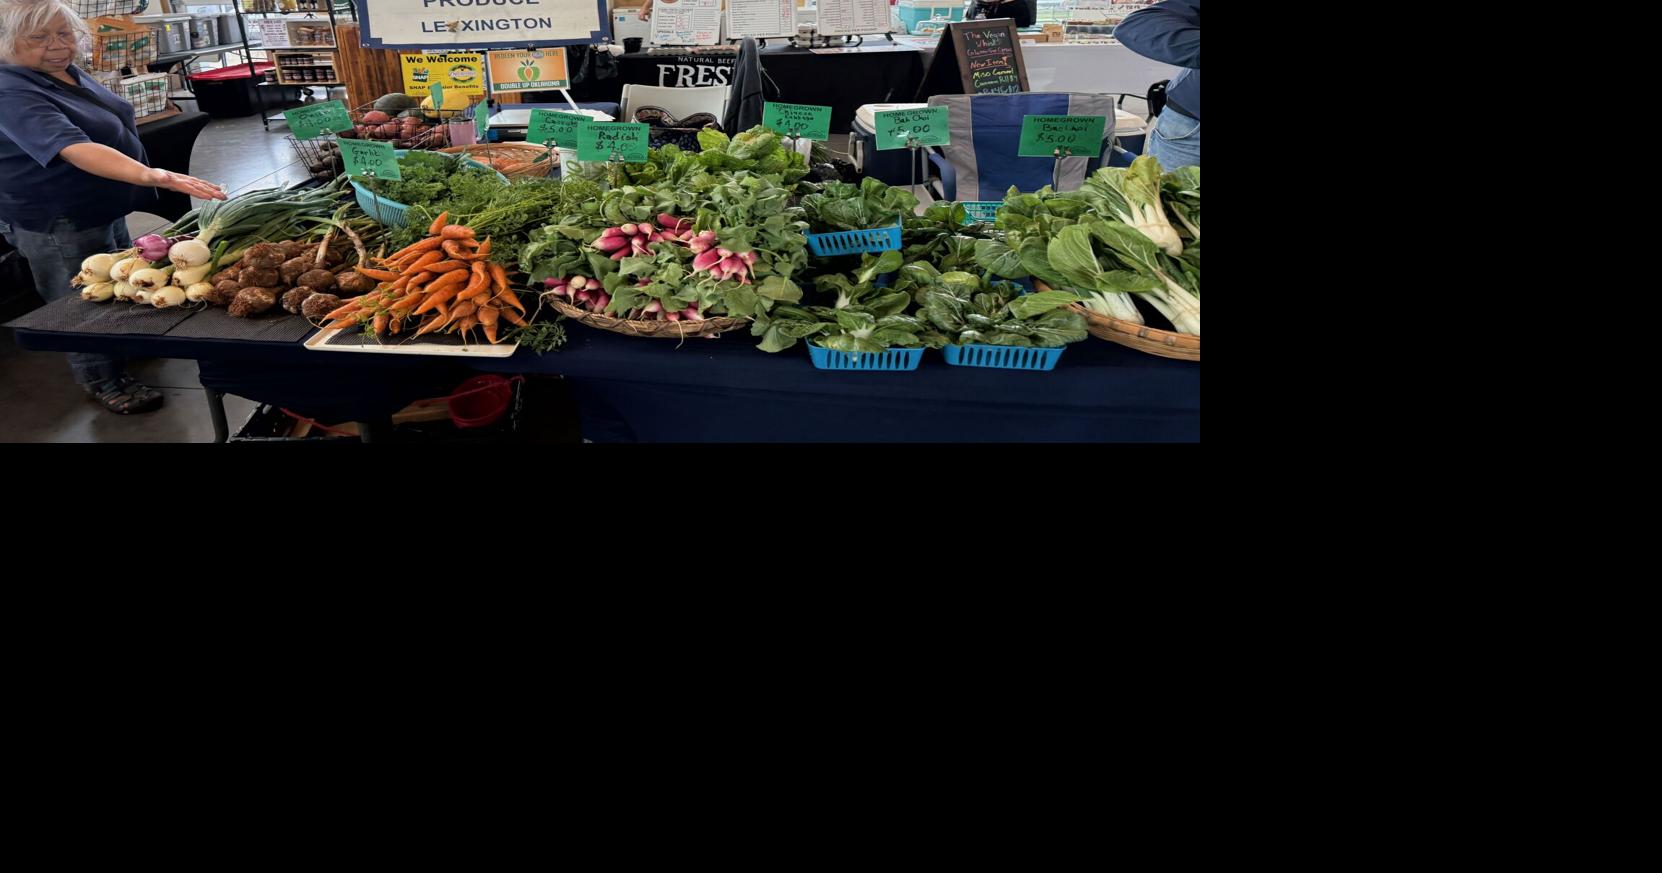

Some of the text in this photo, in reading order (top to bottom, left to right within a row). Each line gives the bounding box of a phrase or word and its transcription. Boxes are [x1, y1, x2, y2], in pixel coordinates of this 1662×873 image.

[426, 55, 478, 63] Welcome
[678, 56, 714, 64] NATURAL
[657, 63, 736, 88] FRES
[538, 111, 586, 122] HOMEGROWN
